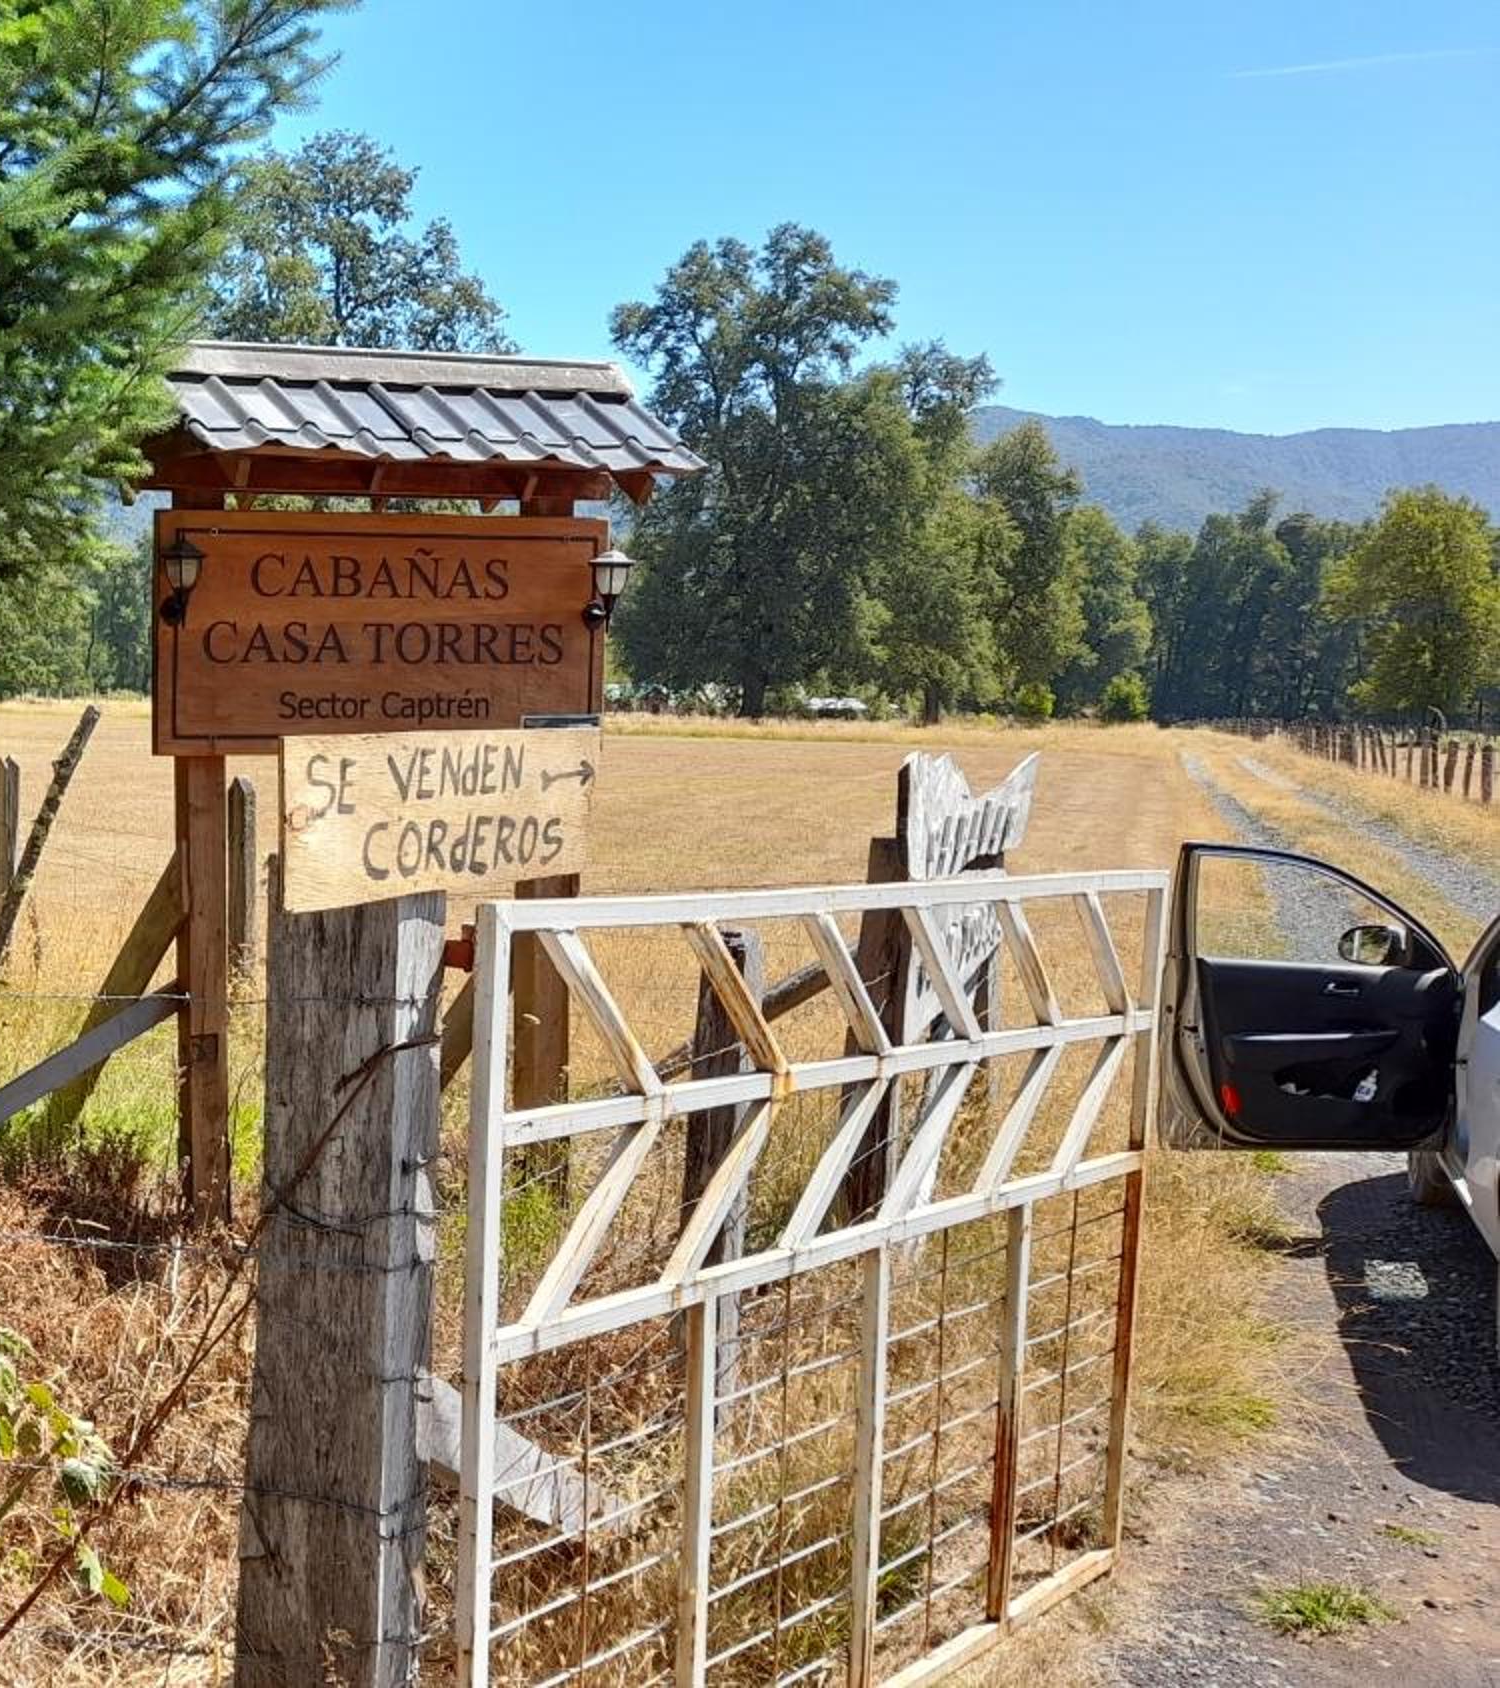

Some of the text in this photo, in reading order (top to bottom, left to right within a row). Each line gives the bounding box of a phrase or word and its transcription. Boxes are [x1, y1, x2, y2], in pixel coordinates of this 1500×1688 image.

[250, 548, 510, 600] CABAÑAS
[202, 621, 564, 665] CASA TORRES
[278, 688, 490, 725] Sector Captrén
[306, 754, 357, 817] SE
